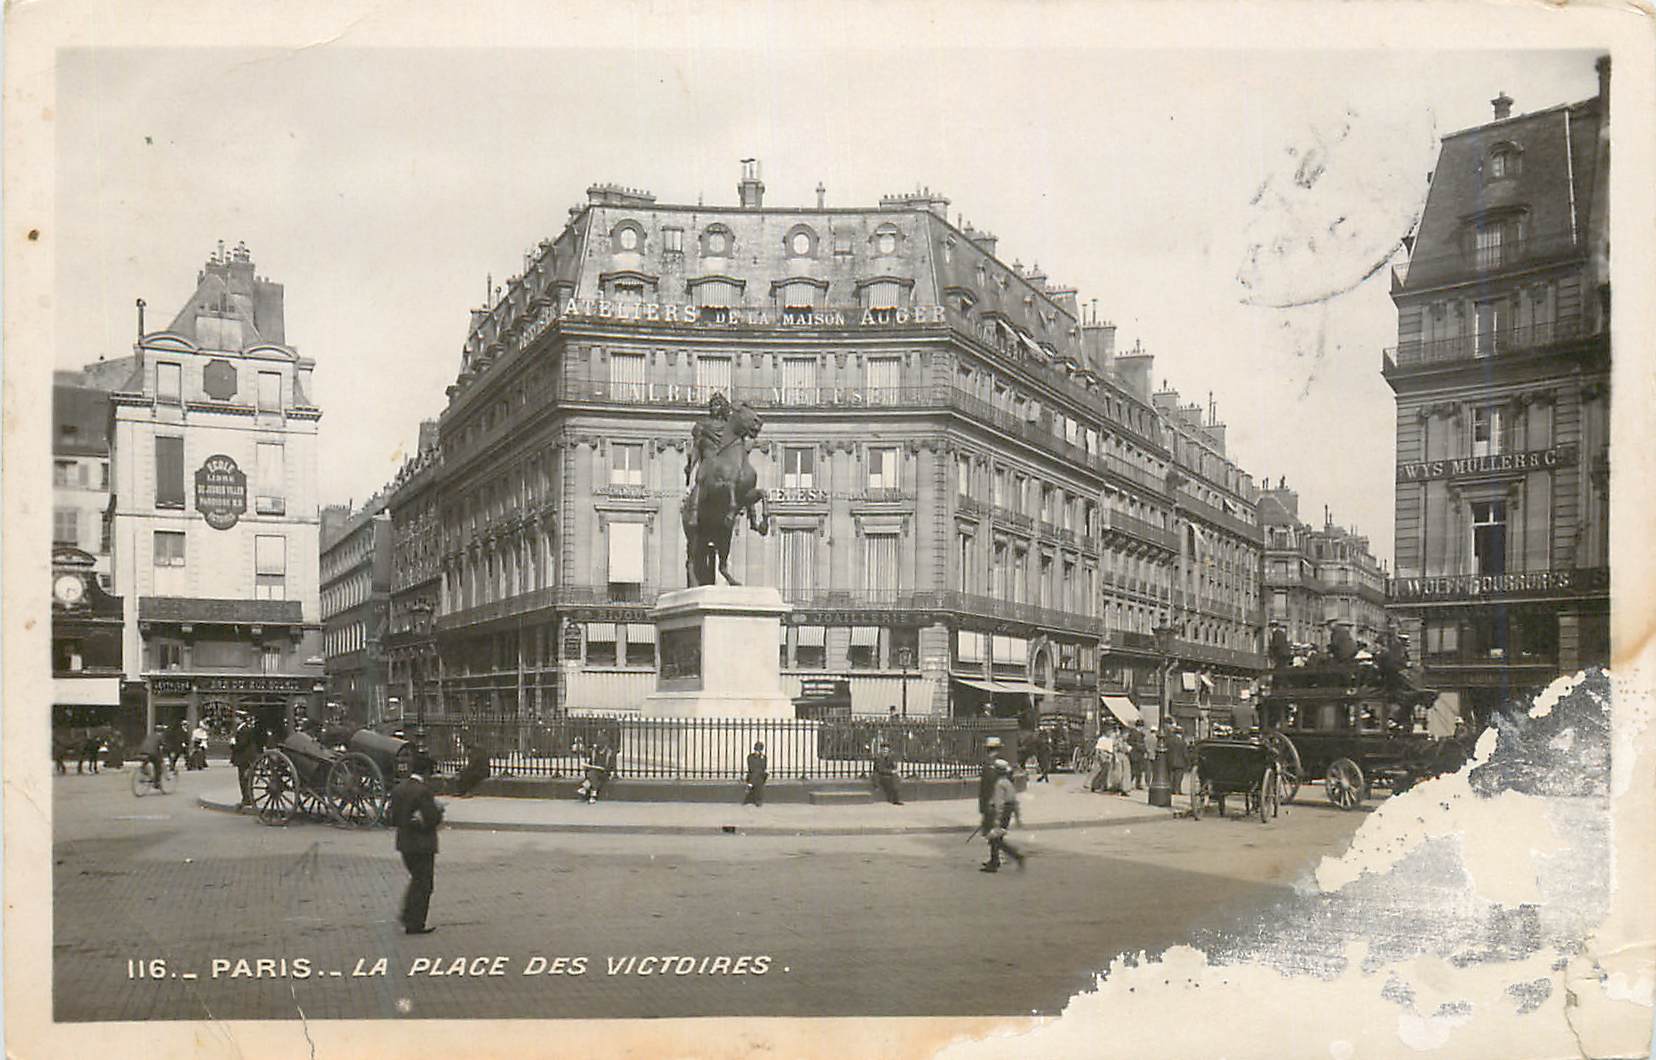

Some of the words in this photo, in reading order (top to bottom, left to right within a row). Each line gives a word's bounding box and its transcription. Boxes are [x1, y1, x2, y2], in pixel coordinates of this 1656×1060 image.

[564, 298, 696, 323] ATELIERS
[715, 308, 738, 324] DE
[748, 312, 769, 325] LA
[782, 313, 845, 326] MAISON
[861, 306, 946, 325] AUGER
[1404, 462, 1443, 478] WYS
[1452, 454, 1525, 475] MULLER
